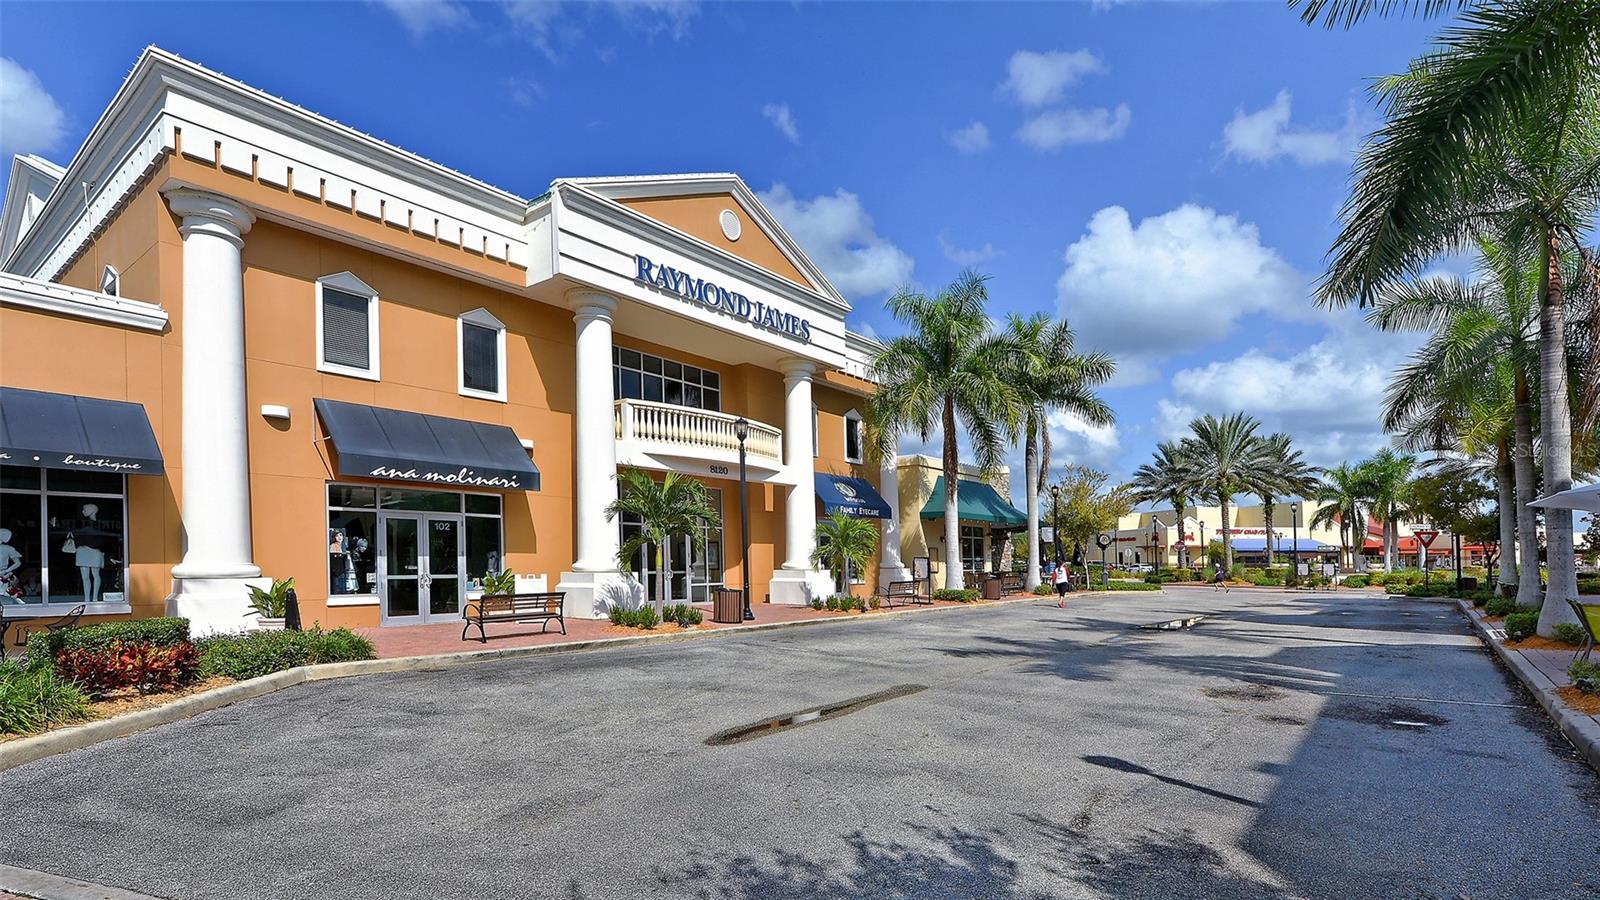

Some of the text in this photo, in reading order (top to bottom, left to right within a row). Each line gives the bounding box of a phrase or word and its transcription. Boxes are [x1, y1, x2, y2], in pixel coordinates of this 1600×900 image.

[634, 254, 810, 341] RAYMOND JAMES
[63, 455, 142, 471] boutique
[709, 465, 728, 475] 8120
[370, 466, 520, 488] ana molinari
[434, 522, 451, 531] 102
